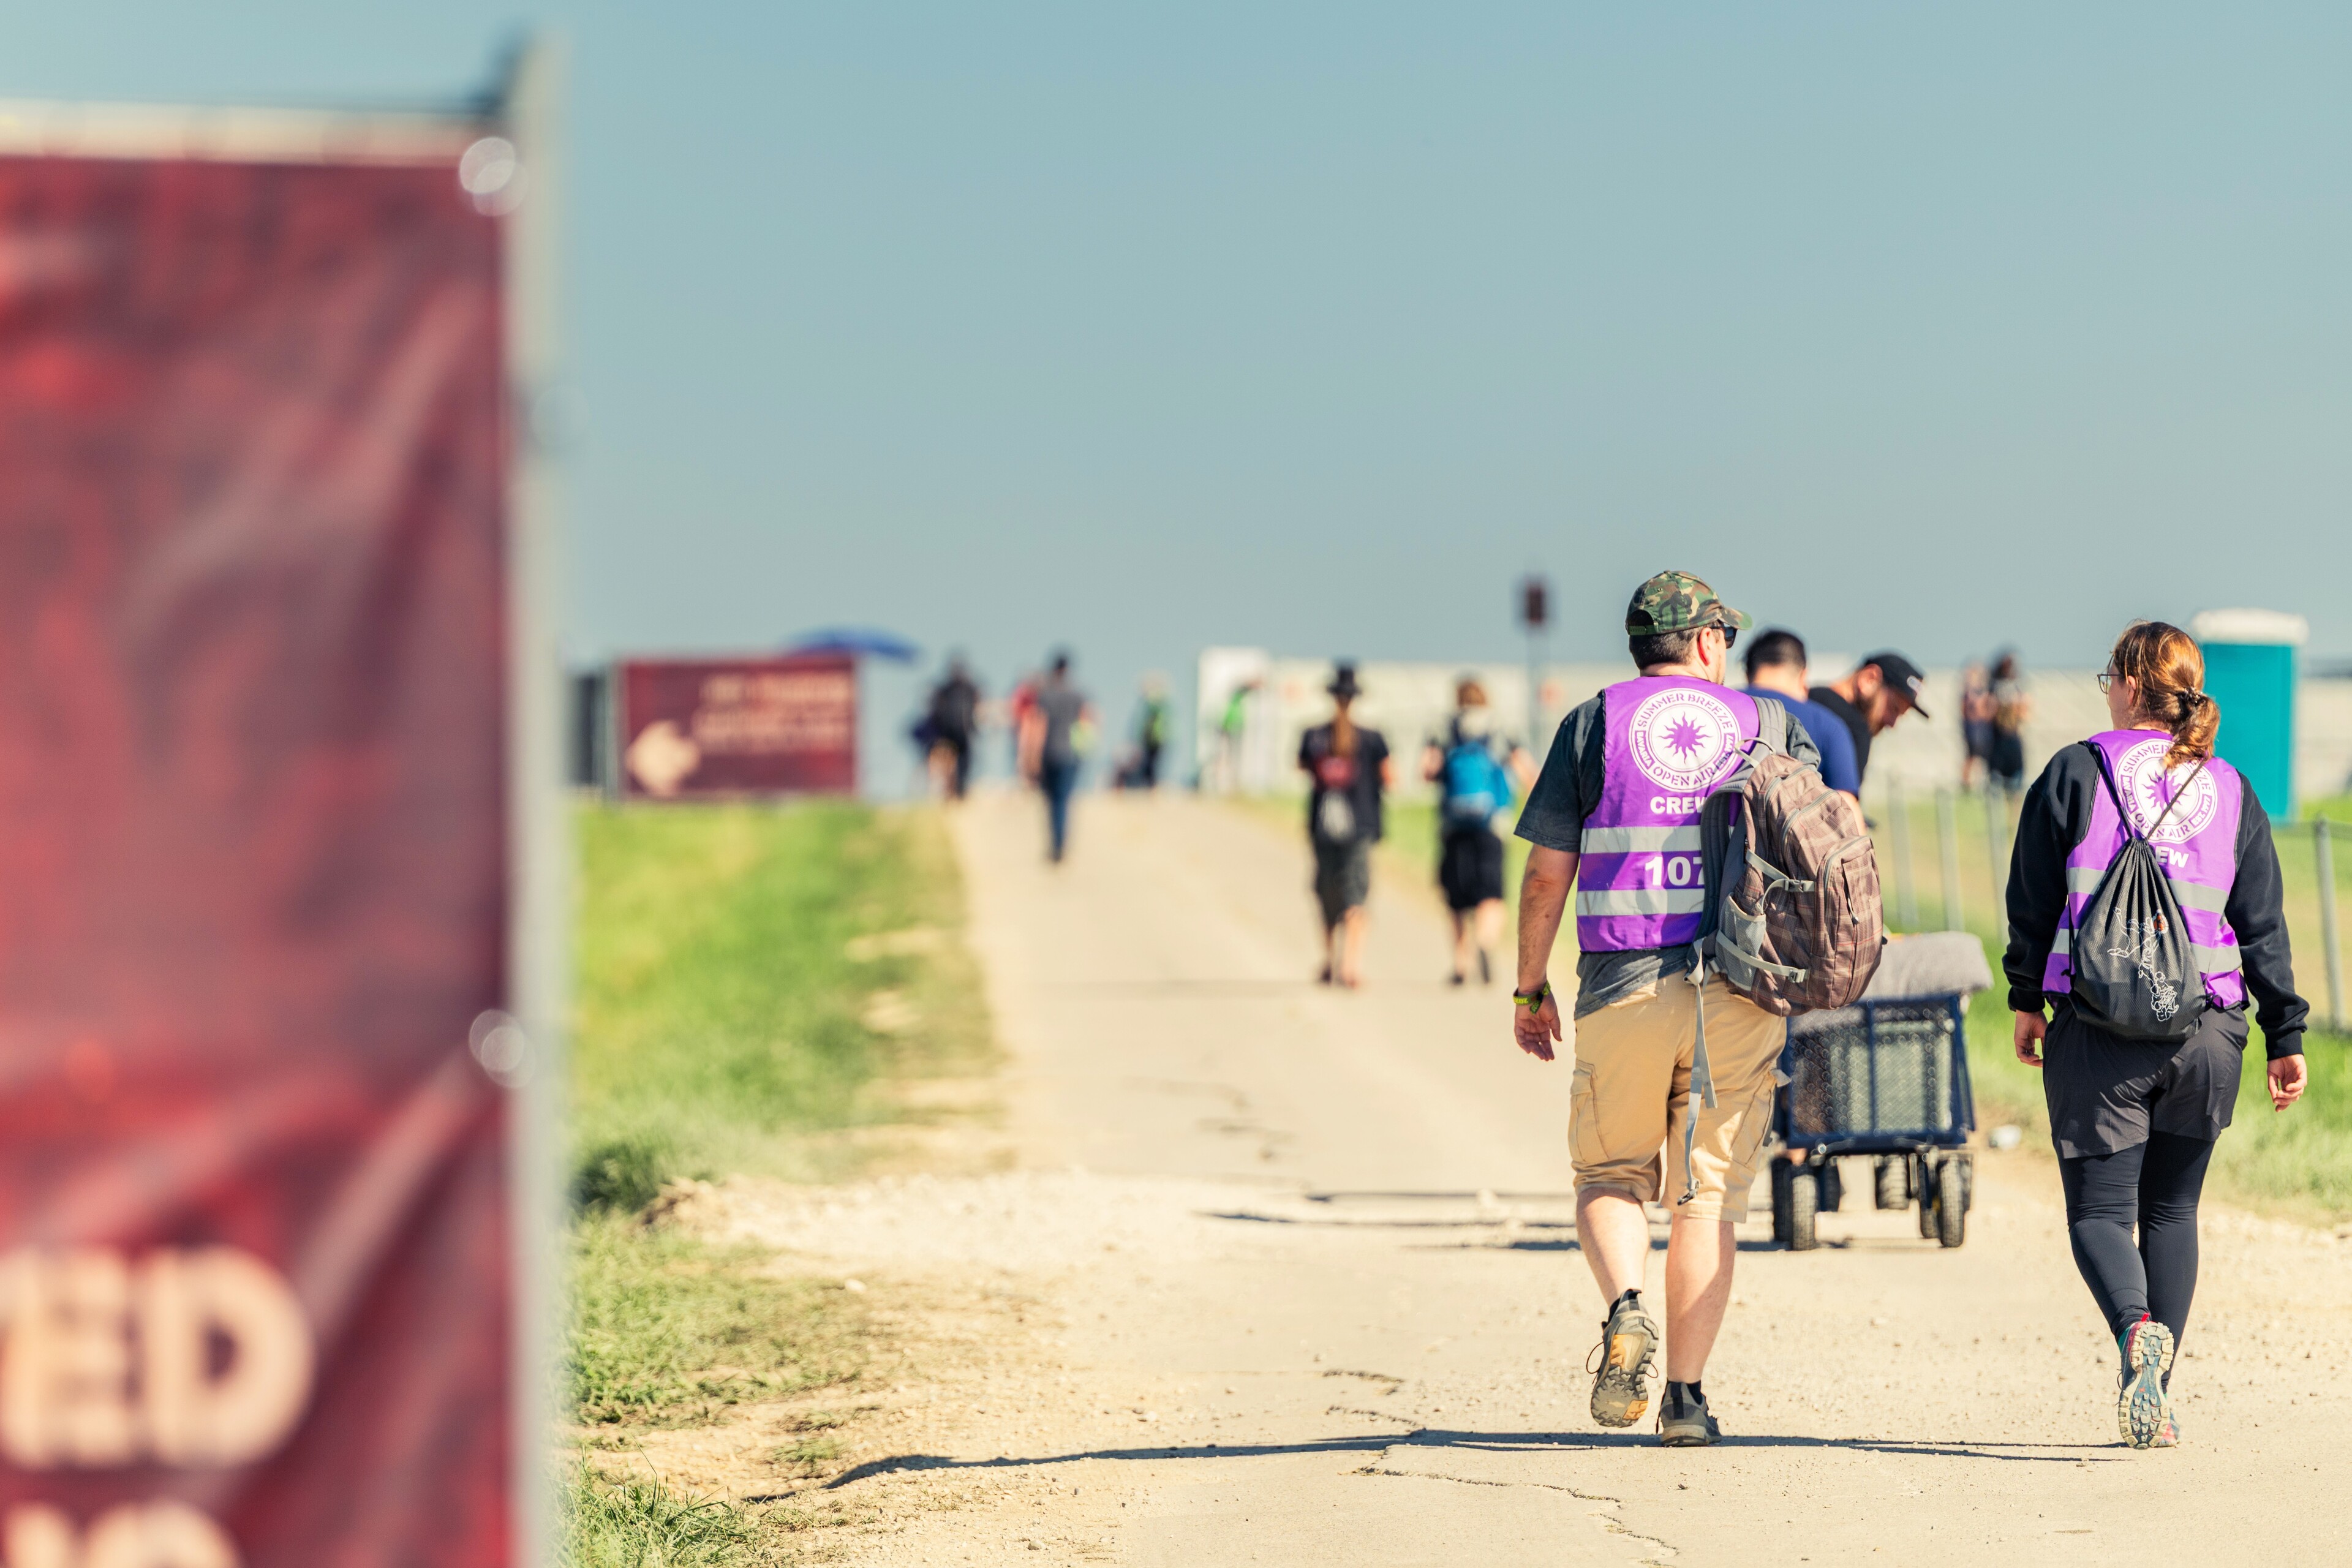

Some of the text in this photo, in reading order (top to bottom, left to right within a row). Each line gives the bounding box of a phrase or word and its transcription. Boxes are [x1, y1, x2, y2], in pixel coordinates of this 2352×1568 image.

[1637, 693, 1733, 729] SUMMER BREEZE
[1636, 733, 1652, 767] BAVARIA
[1653, 766, 1715, 786] OPEN AIR
[2122, 777, 2136, 812] BAVARIA
[2169, 824, 2190, 838] AIR
[2155, 845, 2190, 868] EW
